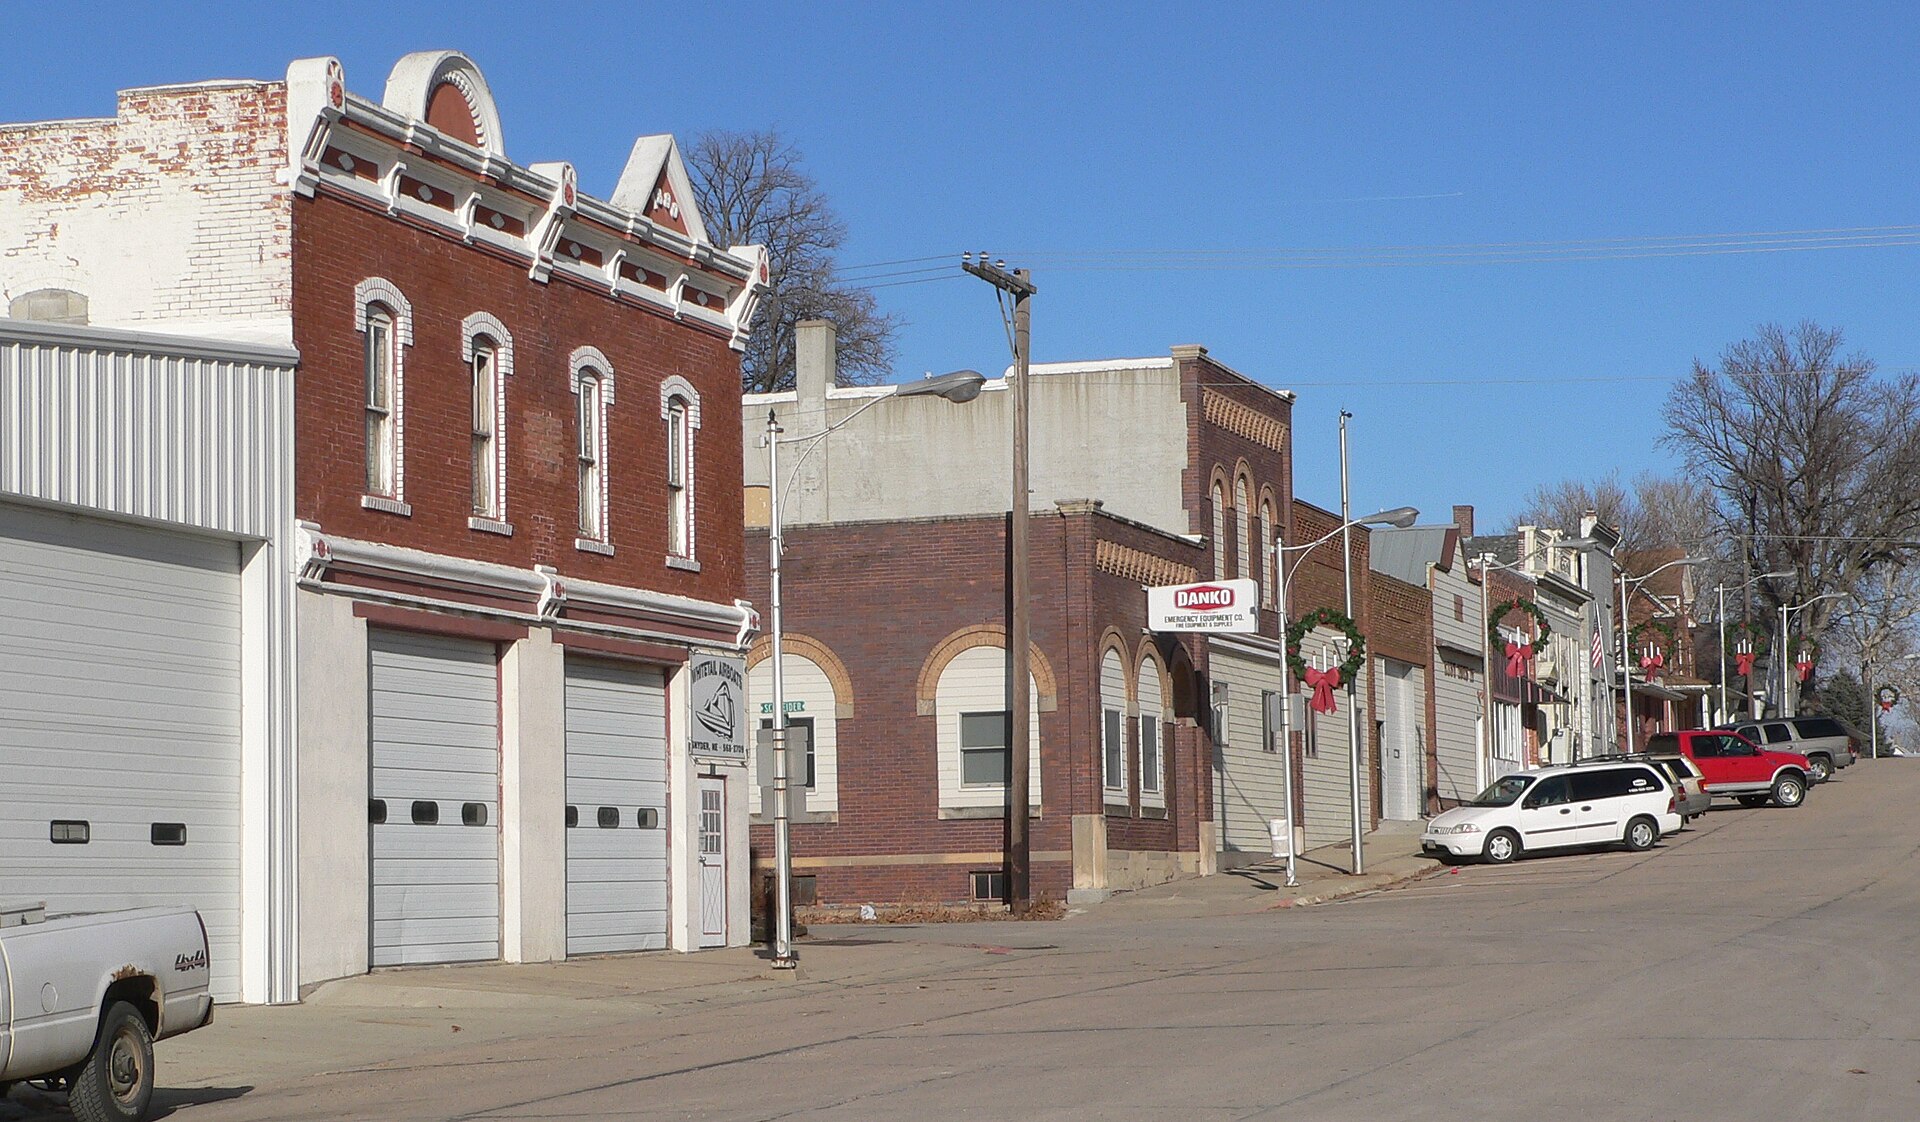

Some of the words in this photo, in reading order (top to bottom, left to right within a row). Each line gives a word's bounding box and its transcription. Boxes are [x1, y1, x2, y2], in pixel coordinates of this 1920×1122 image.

[1178, 589, 1231, 607] DANKO
[1164, 615, 1198, 624] EMERGENCY
[1200, 614, 1233, 622] EQUIPMENT
[1234, 613, 1244, 621] CO.
[692, 660, 717, 684] WHITETAIL
[719, 661, 742, 691] AIRBOATS
[763, 702, 801, 713] SCEIDER
[712, 743, 718, 751] NE
